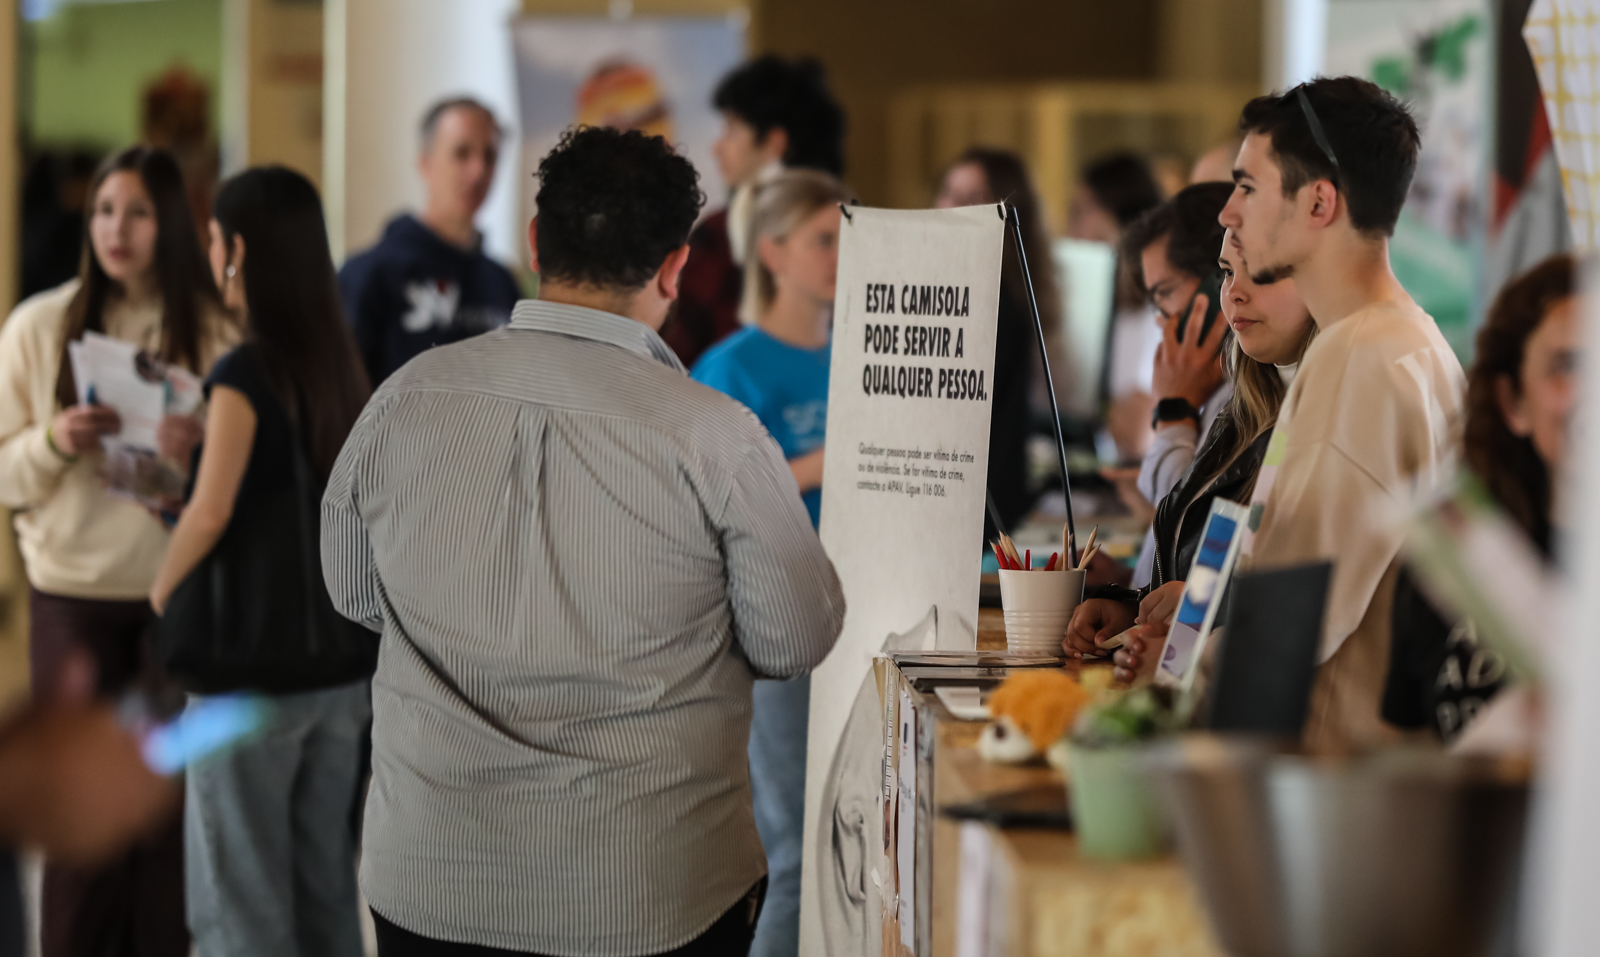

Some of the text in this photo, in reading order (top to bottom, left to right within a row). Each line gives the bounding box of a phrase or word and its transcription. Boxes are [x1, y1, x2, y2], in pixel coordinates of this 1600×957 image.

[866, 284, 969, 317] ESTA CAMISOLA
[864, 324, 964, 358] PODE SERVIR A
[863, 364, 987, 402] QUALQUER PESSOA.
[886, 448, 906, 459] pessoa
[908, 446, 922, 461] pode
[924, 451, 932, 460] ser
[952, 448, 958, 462] de
[960, 450, 974, 463] crime
[858, 464, 866, 472] ou
[867, 460, 874, 473] de
[903, 464, 910, 476] Se
[912, 464, 920, 477] for
[940, 466, 946, 479] de
[948, 468, 965, 482] crime,
[906, 482, 920, 498] Ligue
[923, 483, 932, 496] 116
[934, 484, 946, 498] 006.
